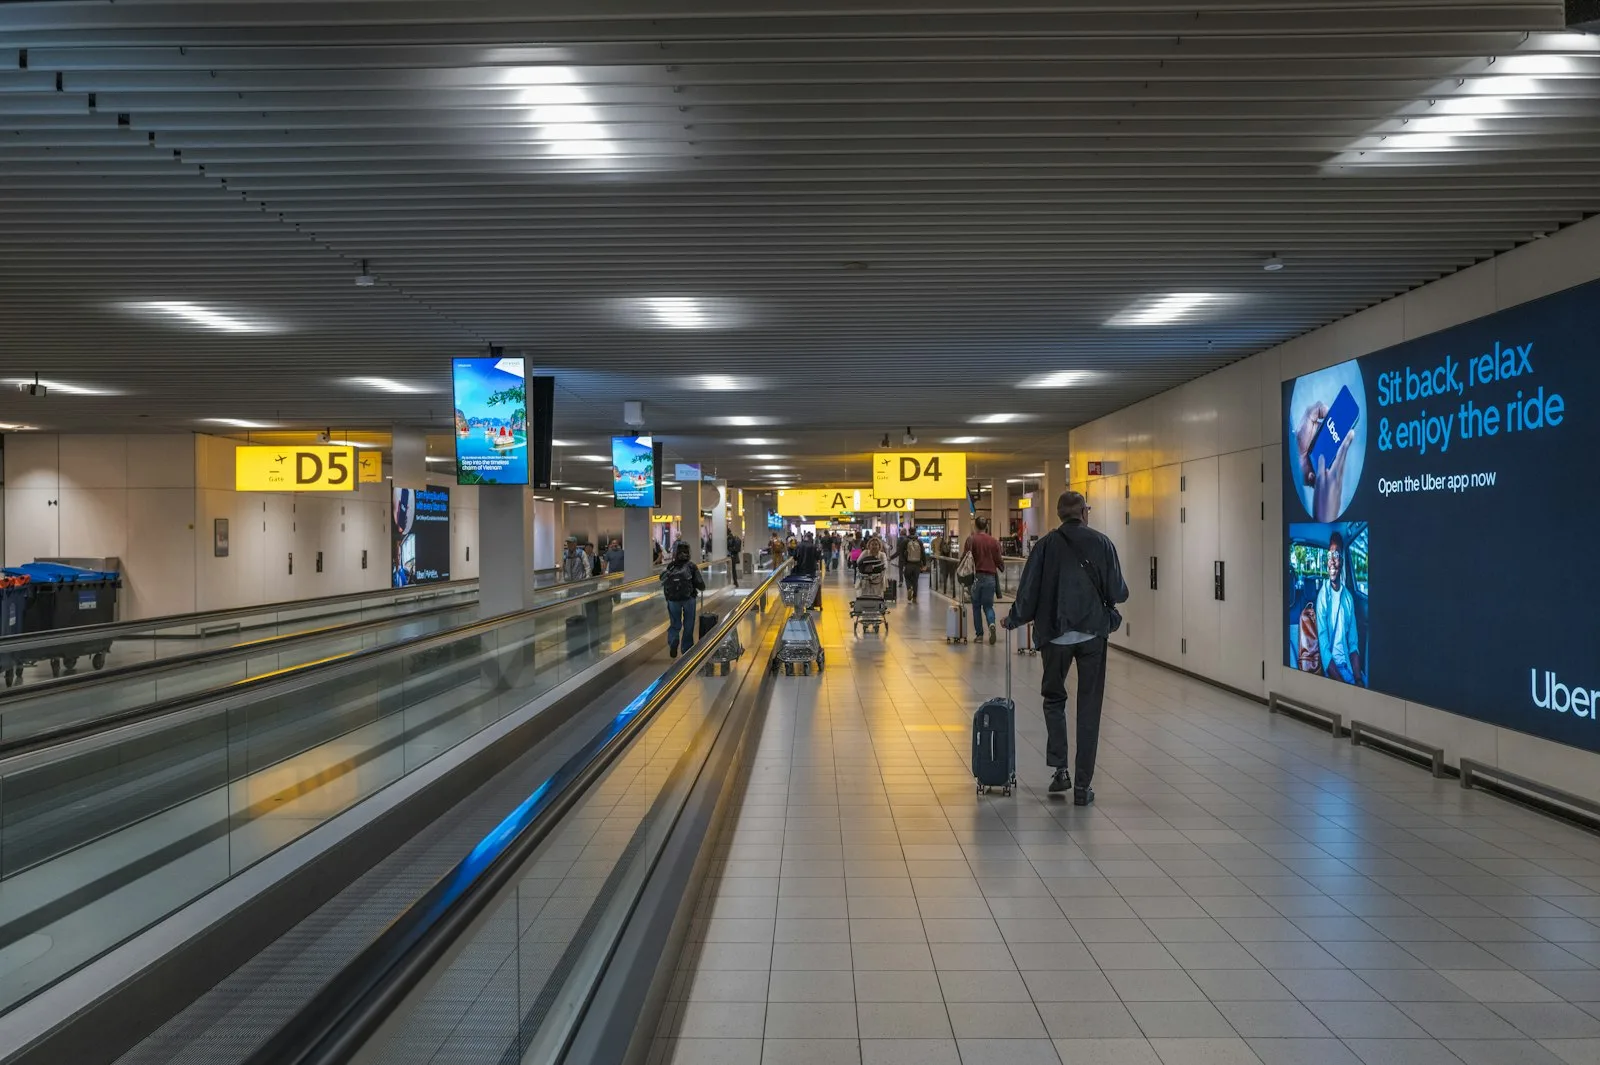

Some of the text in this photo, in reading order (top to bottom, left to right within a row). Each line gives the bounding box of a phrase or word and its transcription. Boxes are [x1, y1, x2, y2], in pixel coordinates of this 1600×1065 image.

[1378, 342, 1534, 406] Sit back, relax
[1326, 416, 1341, 444] Uber
[1377, 387, 1565, 455] & enjoy the ride
[295, 452, 348, 485] D5
[899, 456, 943, 482] D4
[1377, 471, 1497, 498] Open the Uber app now
[830, 492, 847, 509] A
[1531, 668, 1600, 720] Uber
